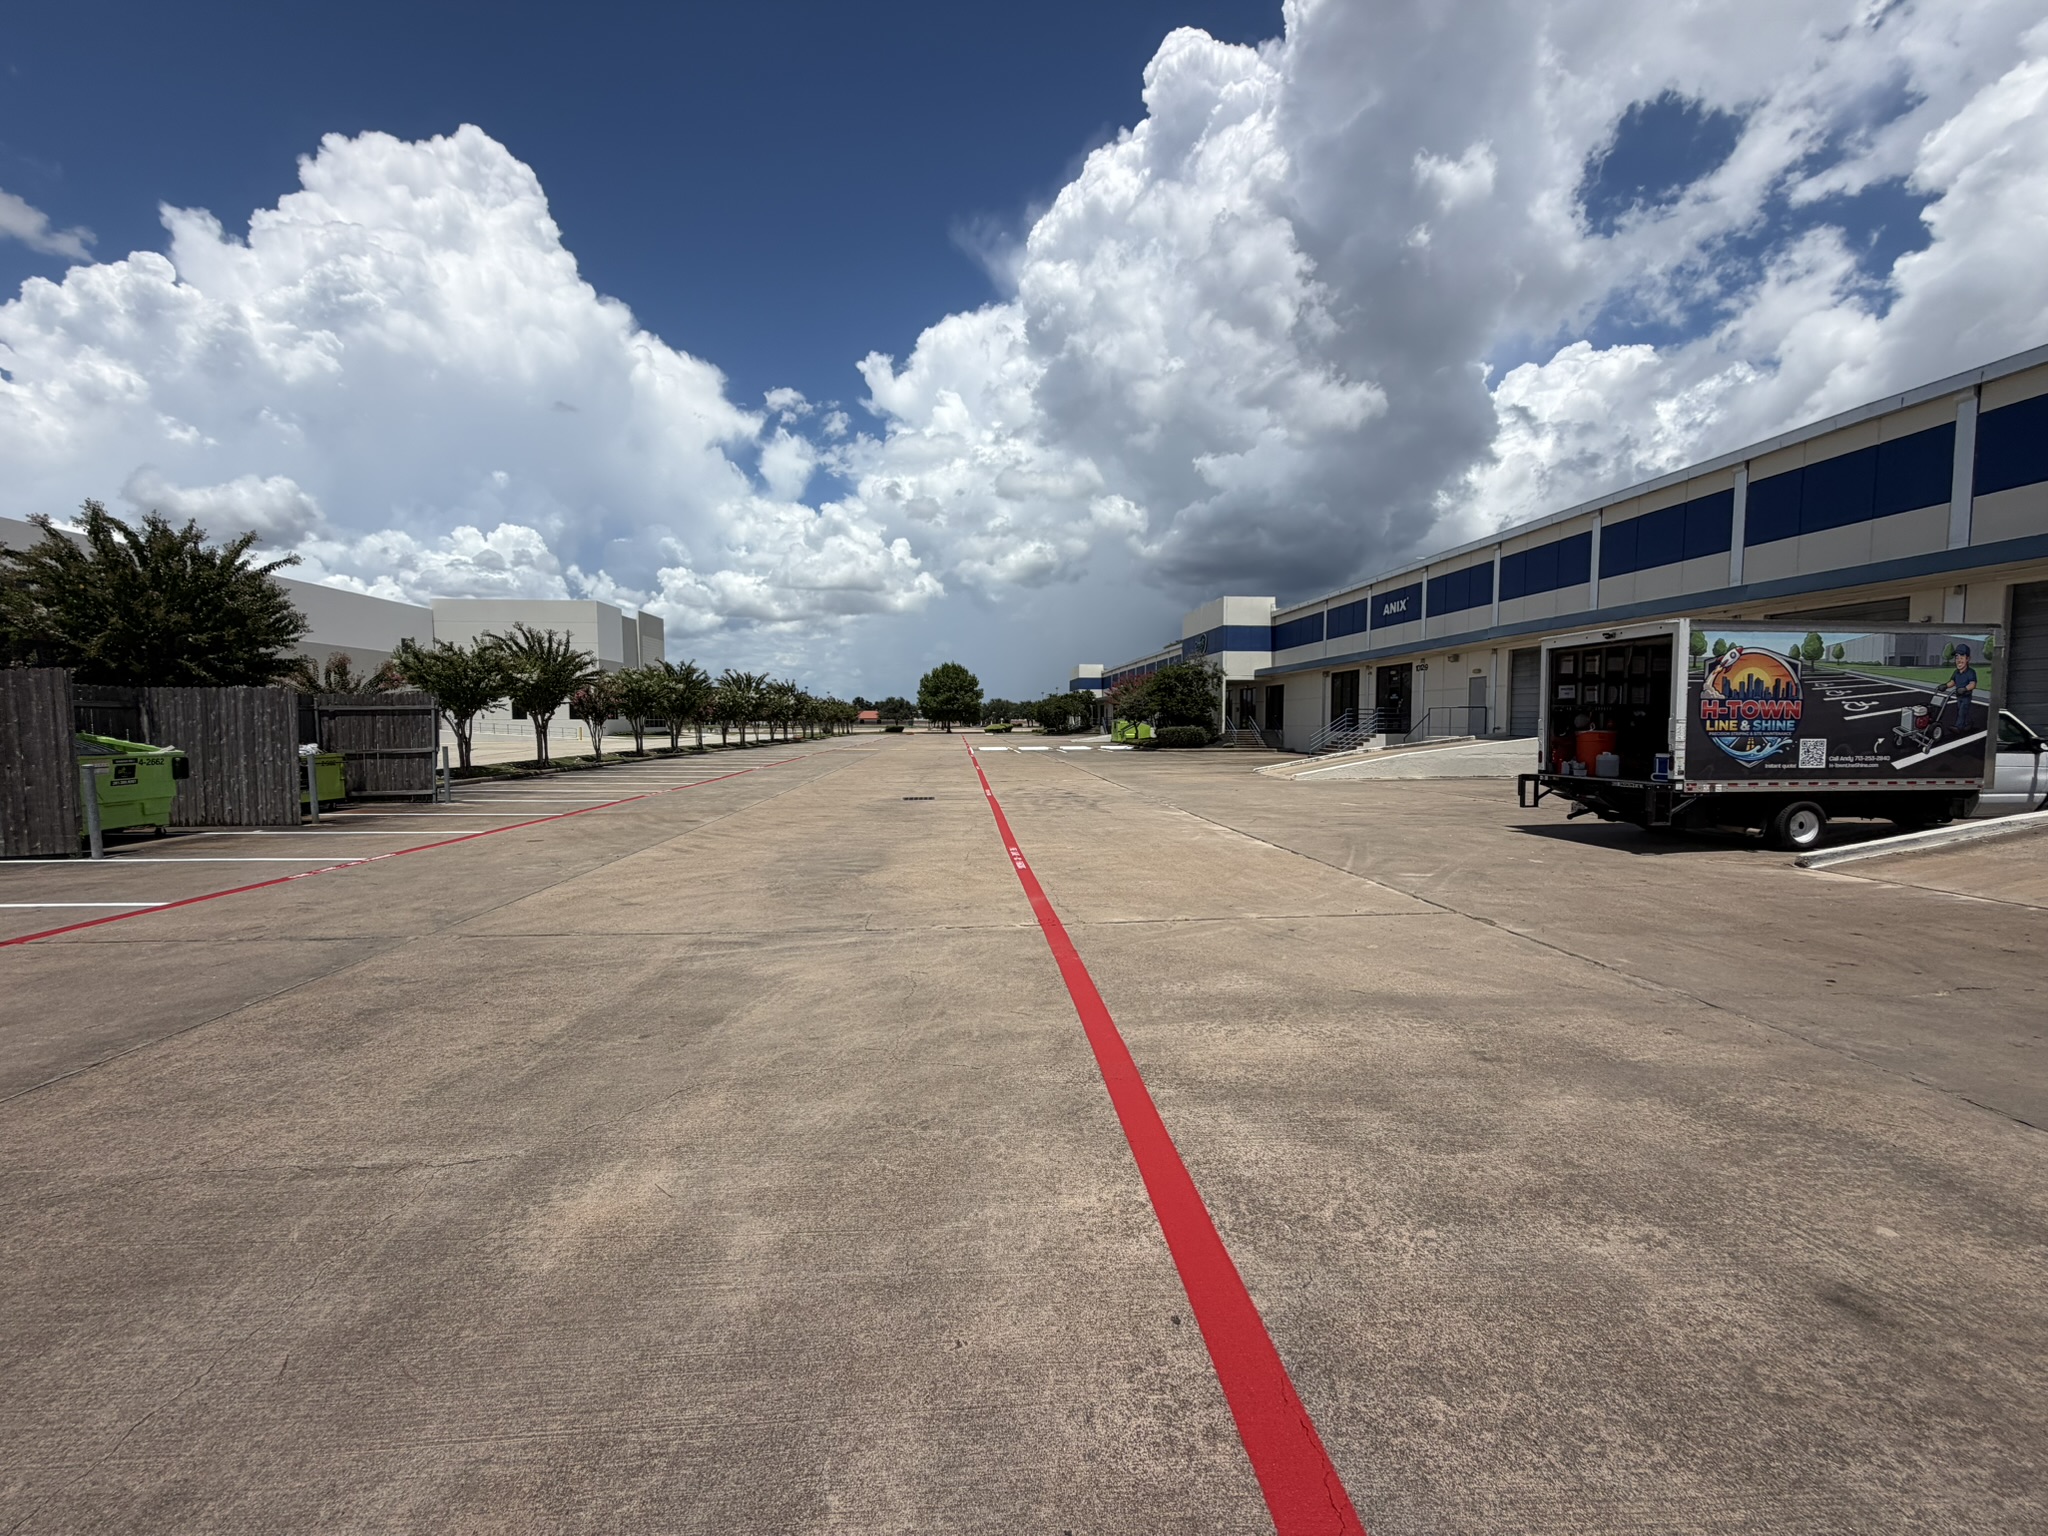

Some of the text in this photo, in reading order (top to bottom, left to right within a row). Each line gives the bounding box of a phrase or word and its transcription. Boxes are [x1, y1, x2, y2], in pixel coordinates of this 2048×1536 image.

[1383, 599, 1407, 616] ANIX
[1701, 700, 1802, 719] H-TOWN
[1706, 720, 1795, 731] LINE & SHINE
[1839, 755, 1854, 763] Andy
